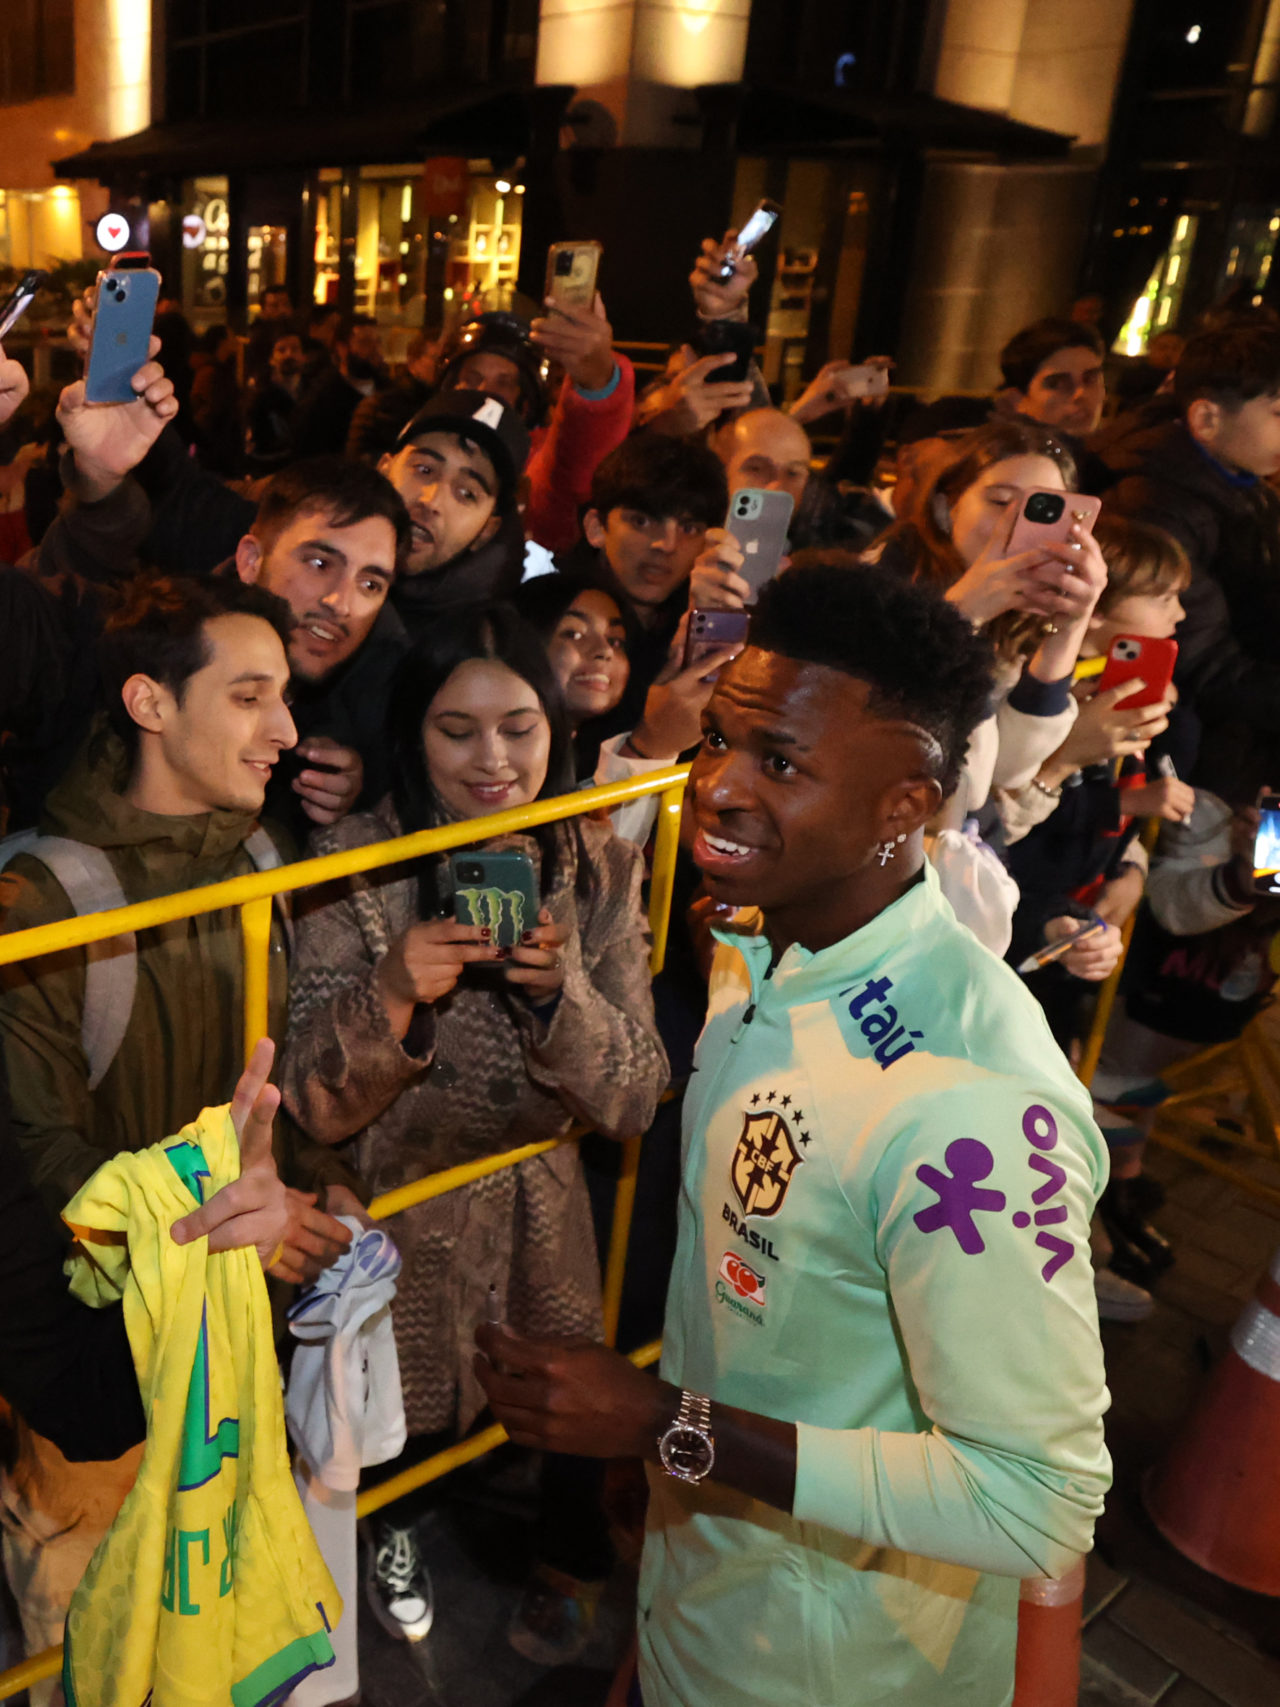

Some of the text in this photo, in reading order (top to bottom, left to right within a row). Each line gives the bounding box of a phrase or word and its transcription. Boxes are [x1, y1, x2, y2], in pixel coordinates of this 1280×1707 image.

[839, 976, 924, 1072] taú
[750, 1149, 775, 1172] CBF
[1012, 1104, 1075, 1283] vivo
[722, 1203, 779, 1261] BRASIL
